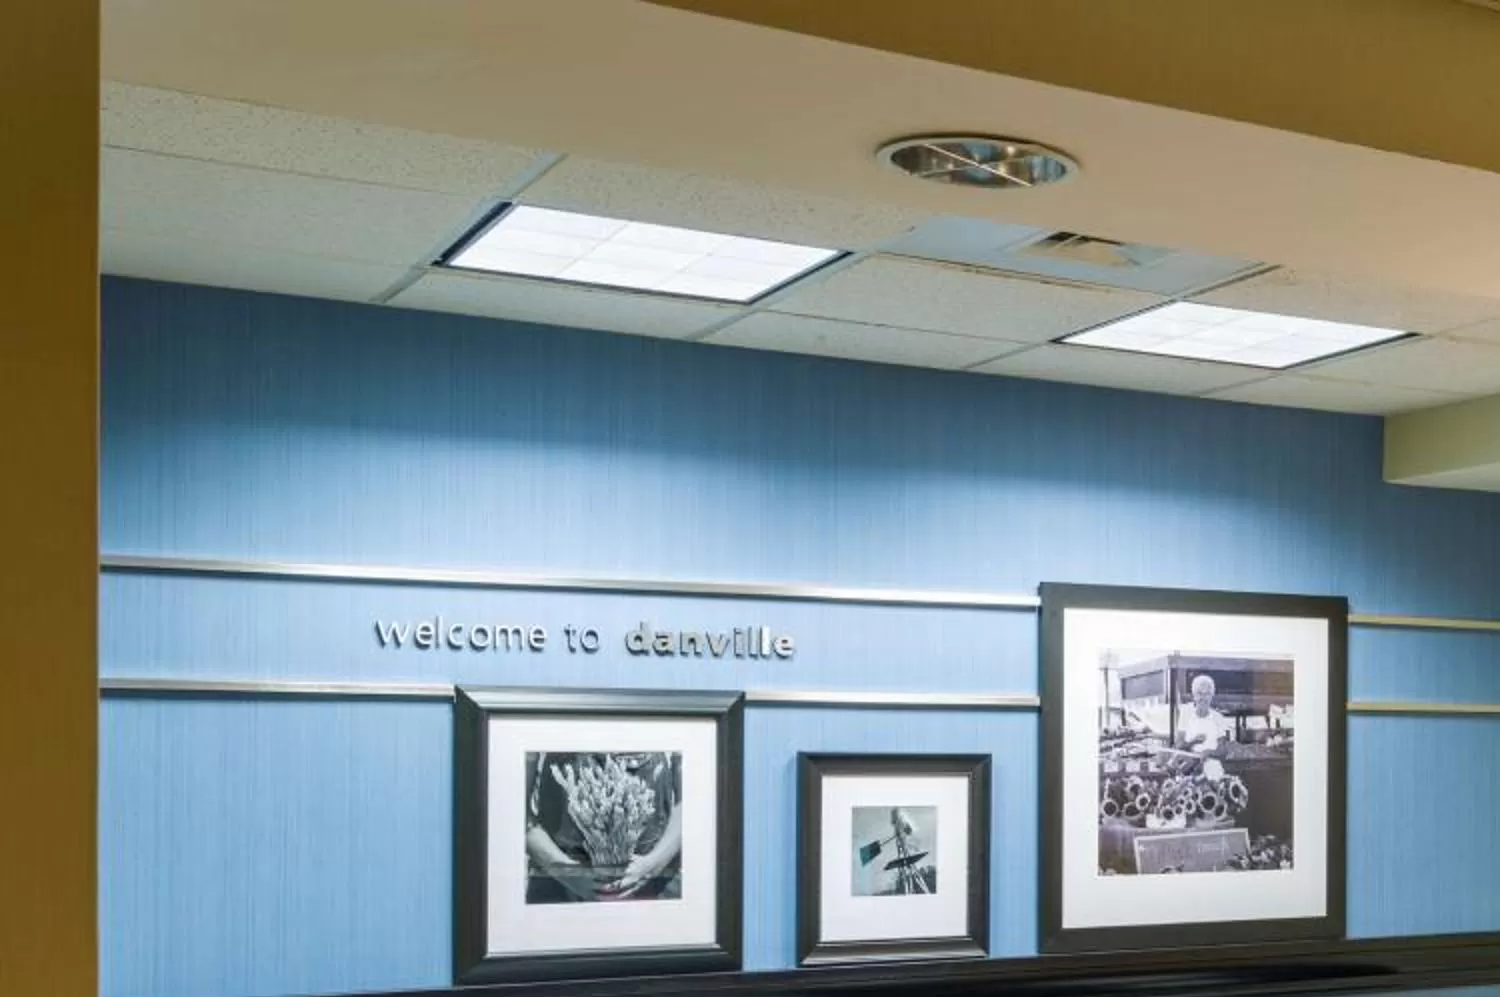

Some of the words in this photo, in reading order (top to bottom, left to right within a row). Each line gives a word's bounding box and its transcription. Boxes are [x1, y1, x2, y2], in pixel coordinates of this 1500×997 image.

[375, 615, 548, 652] welcome
[563, 623, 601, 653] to
[625, 620, 796, 660] danville
